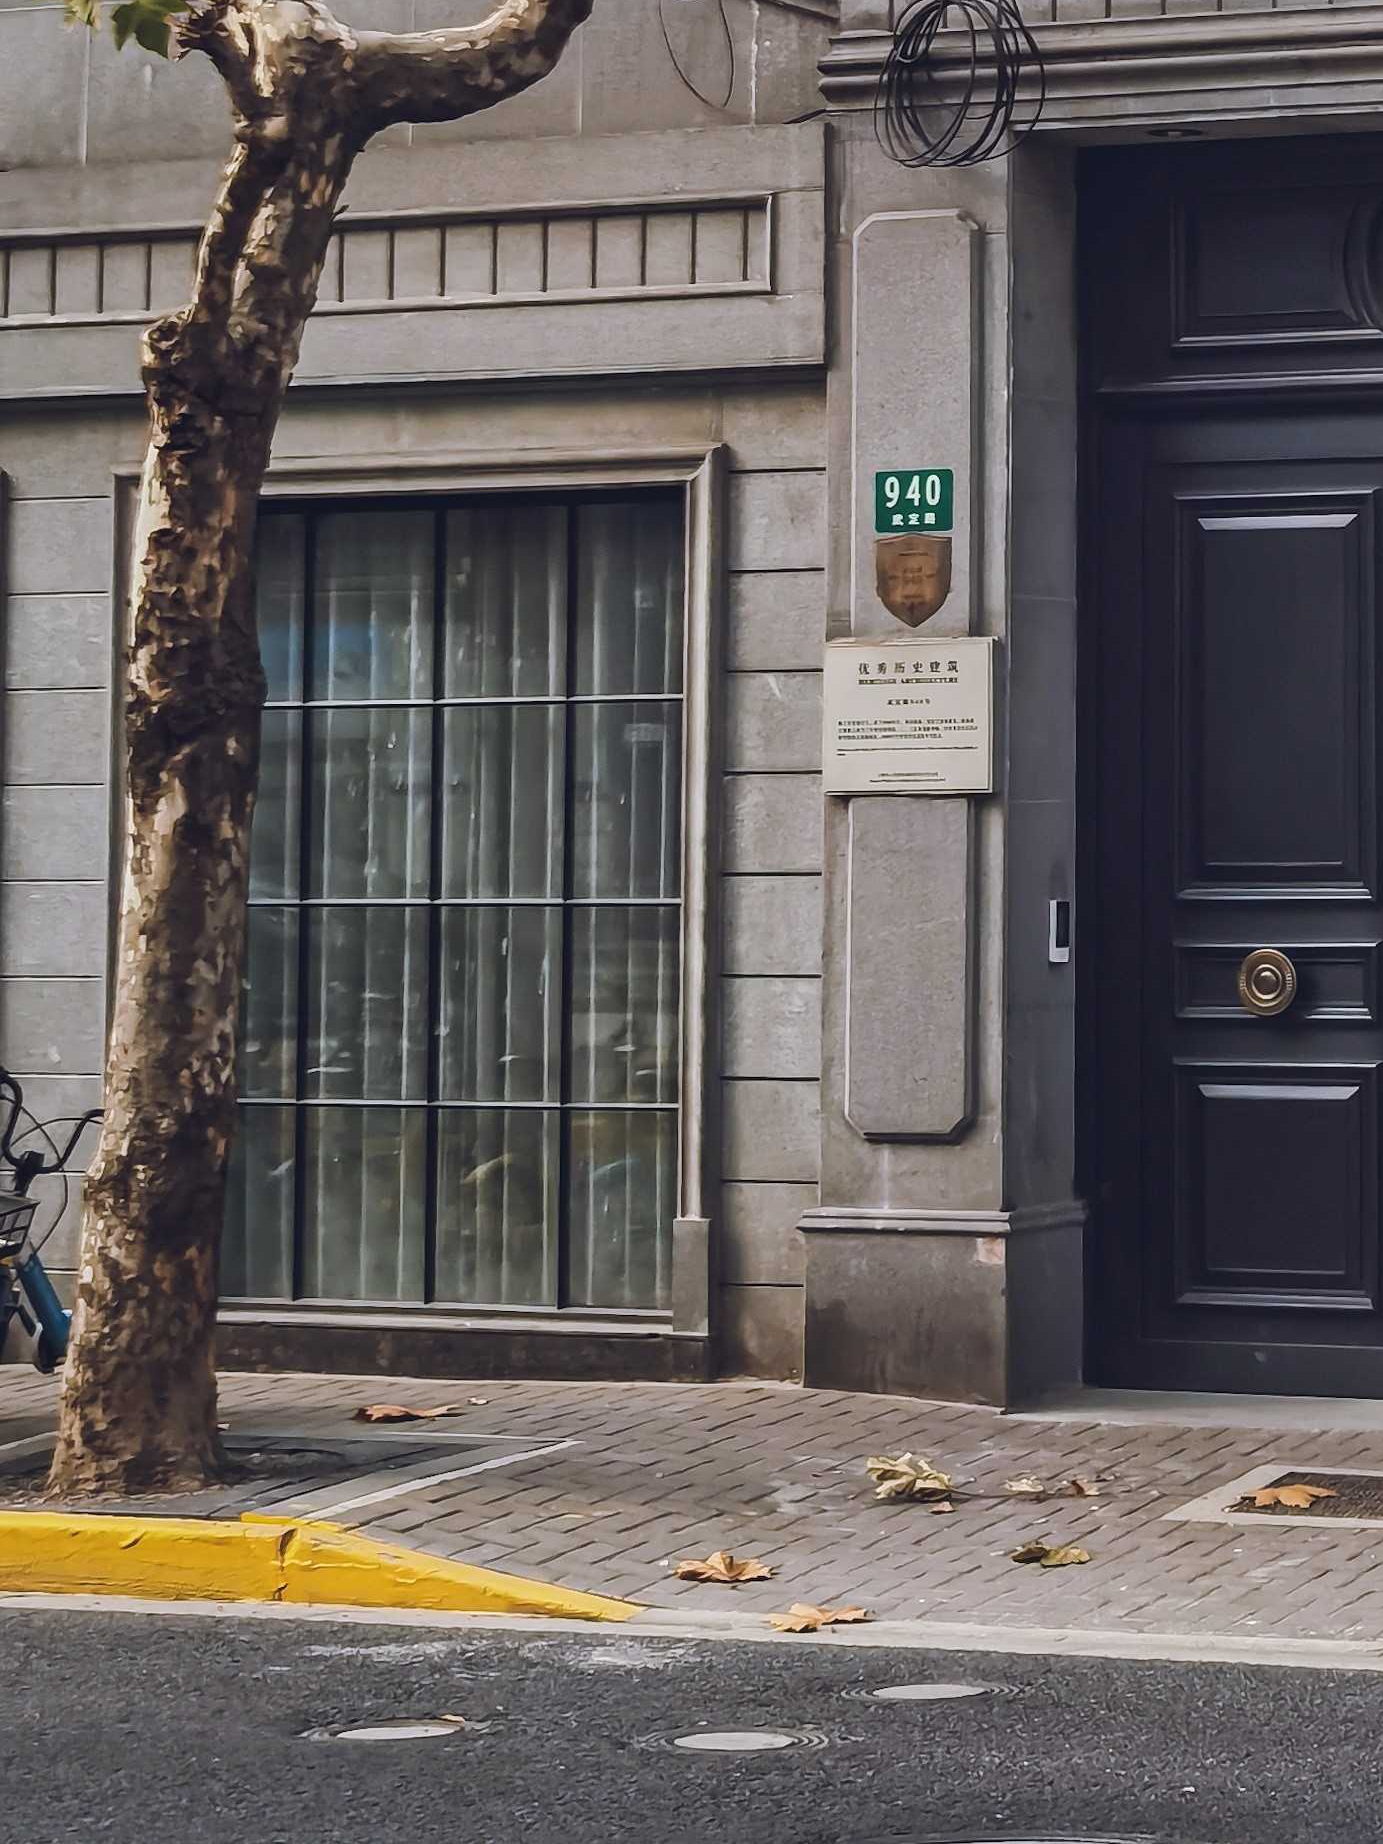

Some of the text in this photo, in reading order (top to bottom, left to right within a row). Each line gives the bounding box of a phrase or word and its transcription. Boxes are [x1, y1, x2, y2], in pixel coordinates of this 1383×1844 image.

[884, 474, 941, 508] 940
[858, 660, 959, 675] 优秀历史建筑
